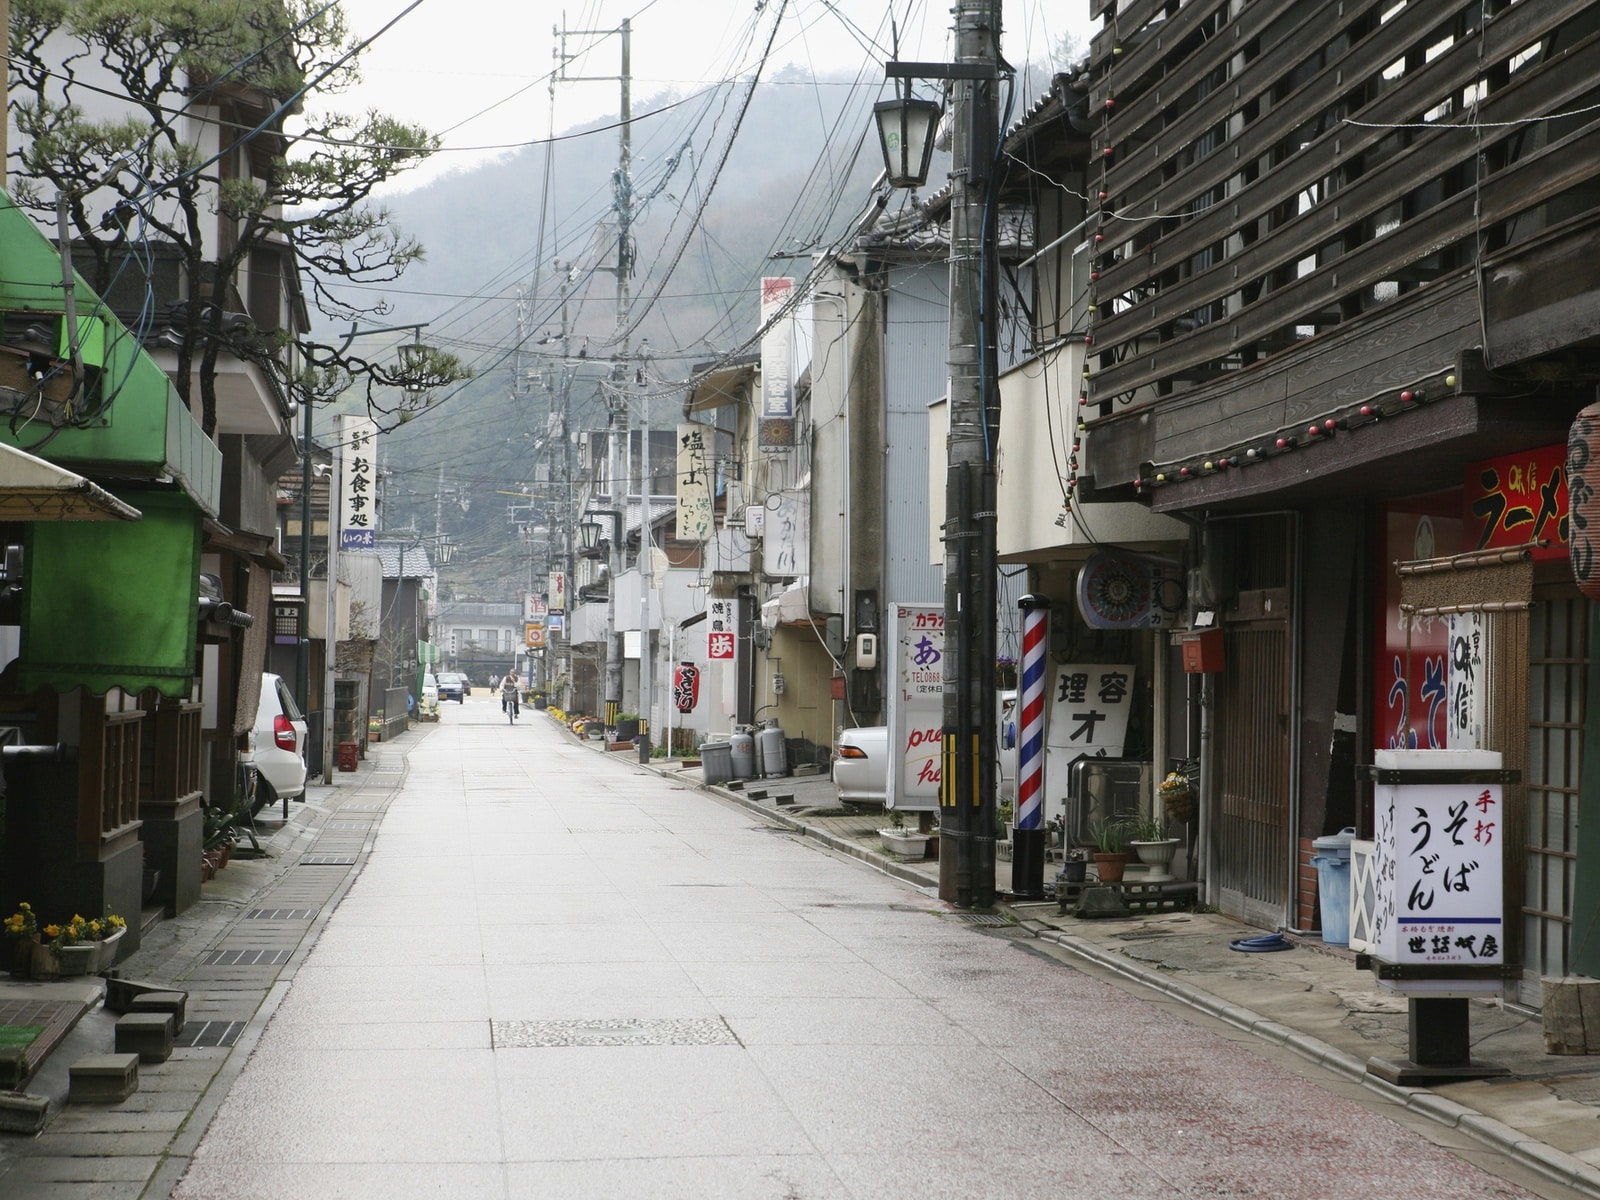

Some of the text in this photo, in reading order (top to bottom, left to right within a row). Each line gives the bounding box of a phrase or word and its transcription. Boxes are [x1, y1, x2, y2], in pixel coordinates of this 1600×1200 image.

[348, 456, 371, 527] お食事処
[530, 595, 547, 614] 酒
[712, 602, 724, 632] 焼鳥
[897, 608, 913, 619] 2F
[711, 635, 732, 658] 歩
[913, 635, 941, 666] あ
[680, 667, 696, 710] やきとり
[902, 689, 913, 702] 1F
[1058, 671, 1129, 704] 理容
[1473, 789, 1496, 846] 手打
[1407, 806, 1440, 911] うどん
[1443, 799, 1479, 893] そば
